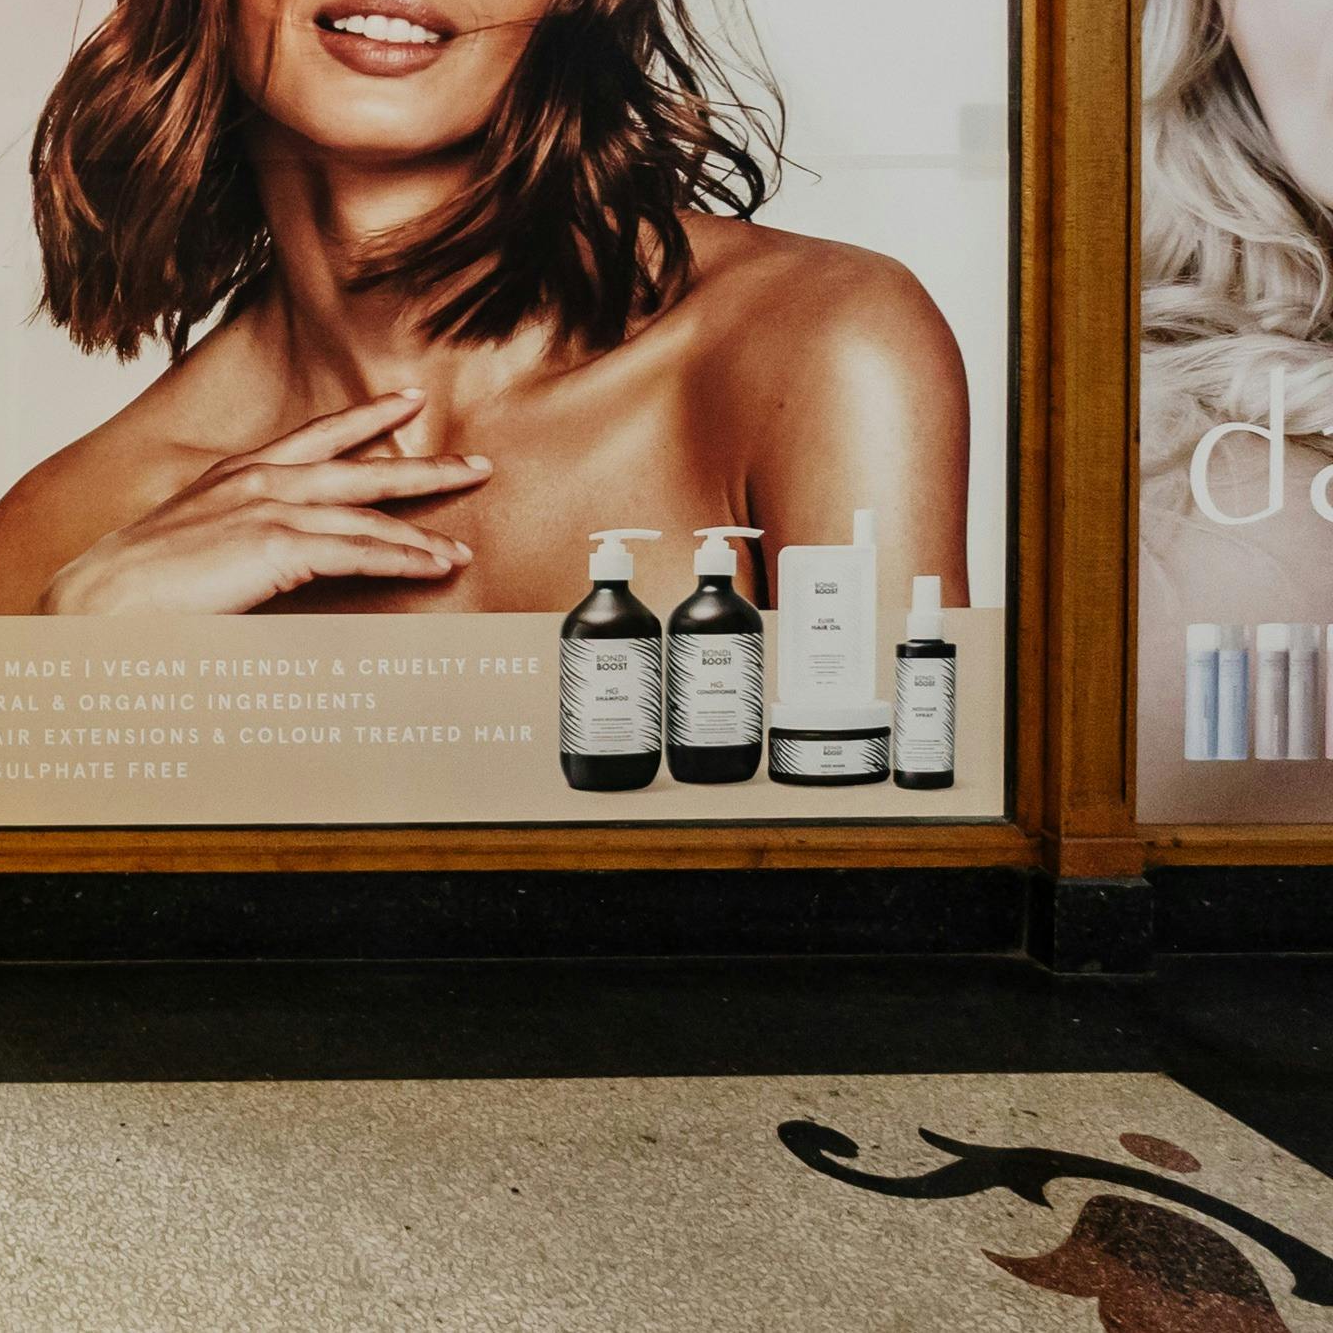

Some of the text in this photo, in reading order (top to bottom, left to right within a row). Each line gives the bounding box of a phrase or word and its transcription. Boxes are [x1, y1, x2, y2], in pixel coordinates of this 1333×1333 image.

[1190, 366, 1333, 525] d
[4, 661, 72, 677] MADE
[102, 660, 186, 677] VEGAN
[199, 659, 319, 676] FRIENDLY
[332, 660, 346, 675] &
[359, 658, 466, 675] CRUELTY
[480, 658, 540, 674] FREE
[596, 663, 628, 671] BOOST
[51, 695, 66, 711] &
[79, 694, 195, 711] ORGANIC
[208, 693, 377, 710] INGREDIENTS
[44, 728, 200, 745] EXTENSIONS
[213, 729, 226, 744] &
[239, 727, 343, 744] COLOUR
[353, 726, 461, 743] TREATED
[474, 725, 533, 742] HAIR
[128, 762, 189, 779] FREE
